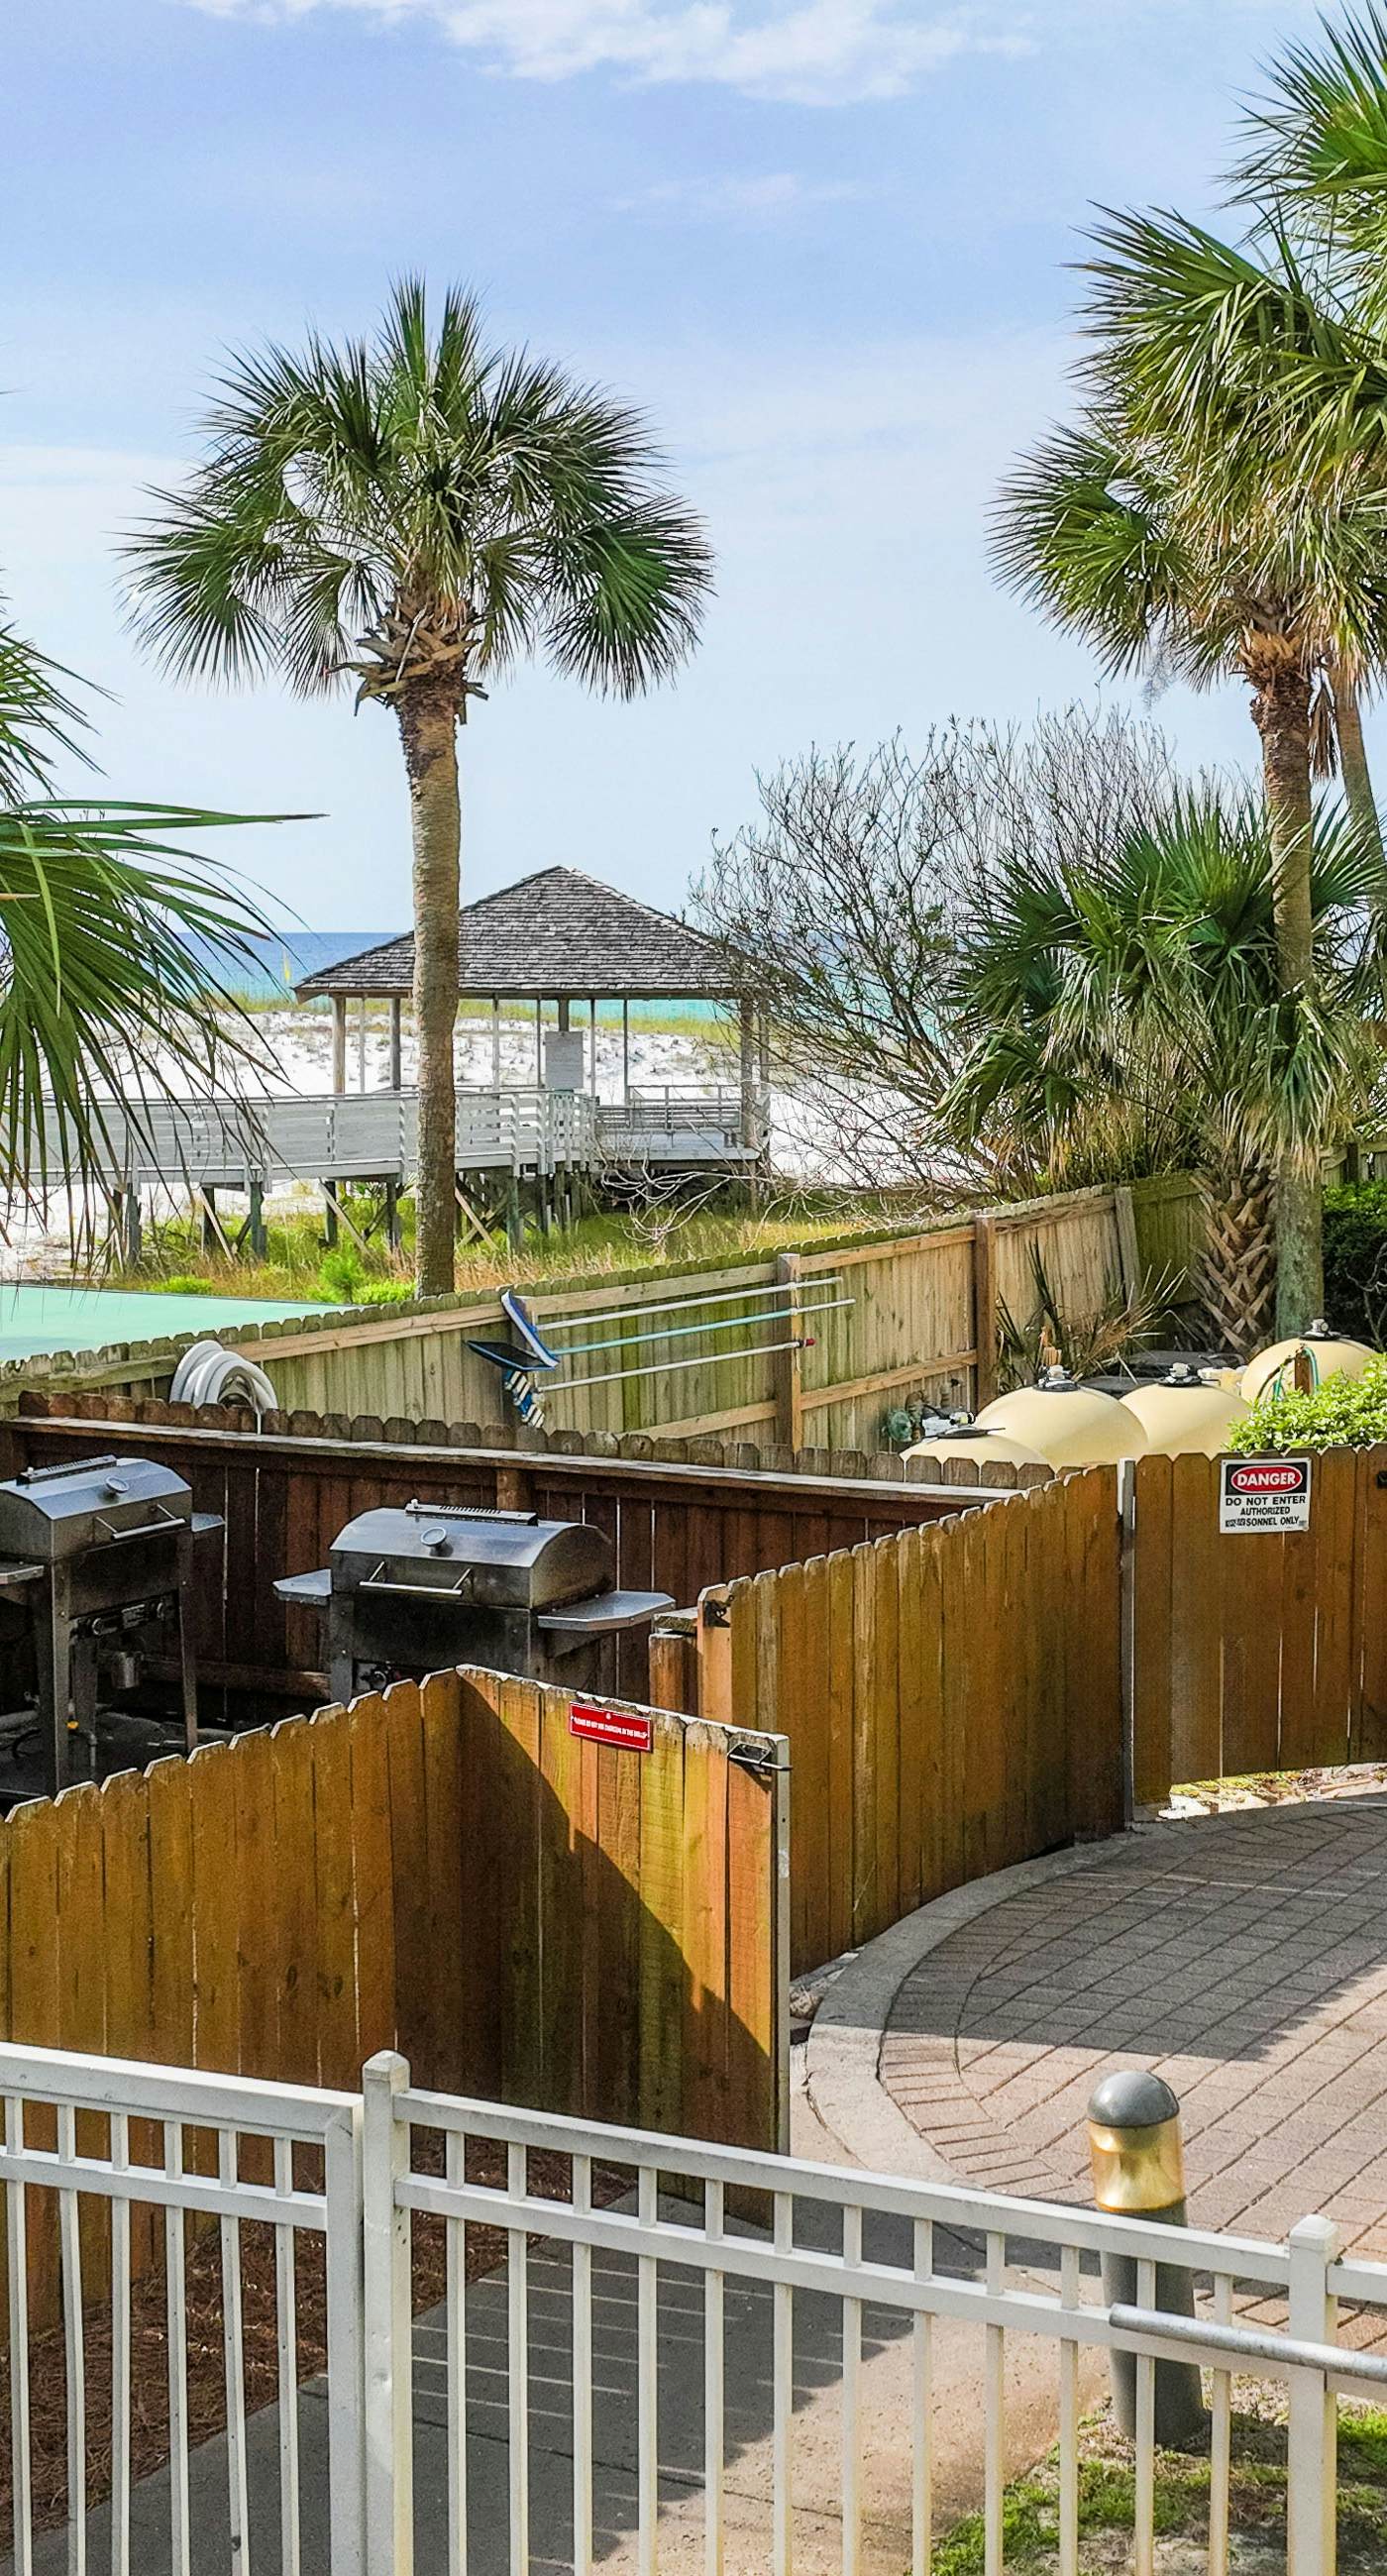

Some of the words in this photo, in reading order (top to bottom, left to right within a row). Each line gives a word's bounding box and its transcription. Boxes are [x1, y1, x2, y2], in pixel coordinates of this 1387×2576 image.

[1236, 1472, 1296, 1486] DANGER
[1226, 1497, 1241, 1506] DO
[1246, 1497, 1268, 1506] NOT
[1272, 1496, 1306, 1505] ENTER
[1240, 1507, 1290, 1516] AUTHORIZED
[1280, 1516, 1300, 1525] ONLY
